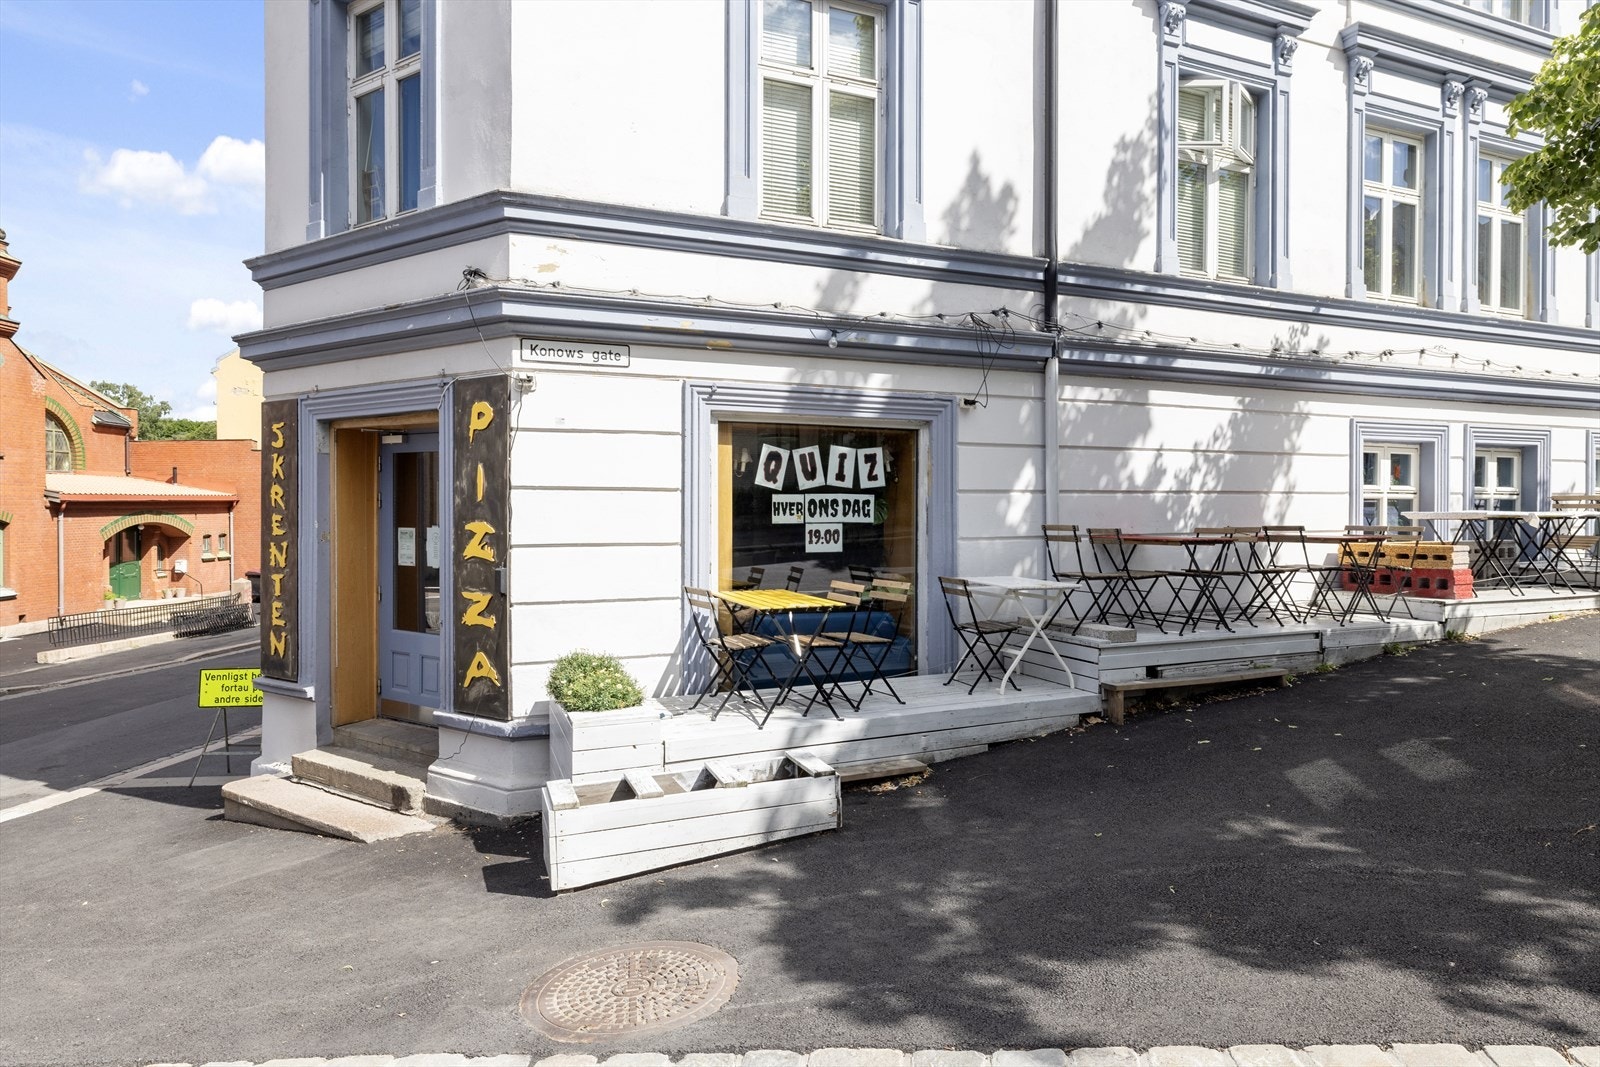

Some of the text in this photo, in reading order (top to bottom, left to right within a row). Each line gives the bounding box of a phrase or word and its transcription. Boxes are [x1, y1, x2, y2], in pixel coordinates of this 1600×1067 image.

[530, 344, 622, 362] Konows gate
[763, 450, 879, 485] QUIZ
[773, 501, 804, 517] HVER
[269, 421, 288, 659] SKRENTEN
[461, 401, 501, 688] PIZZA
[808, 529, 840, 545] 19:00
[205, 672, 248, 682] Vennligst
[221, 684, 249, 692] fortau
[214, 694, 263, 703] andre side
